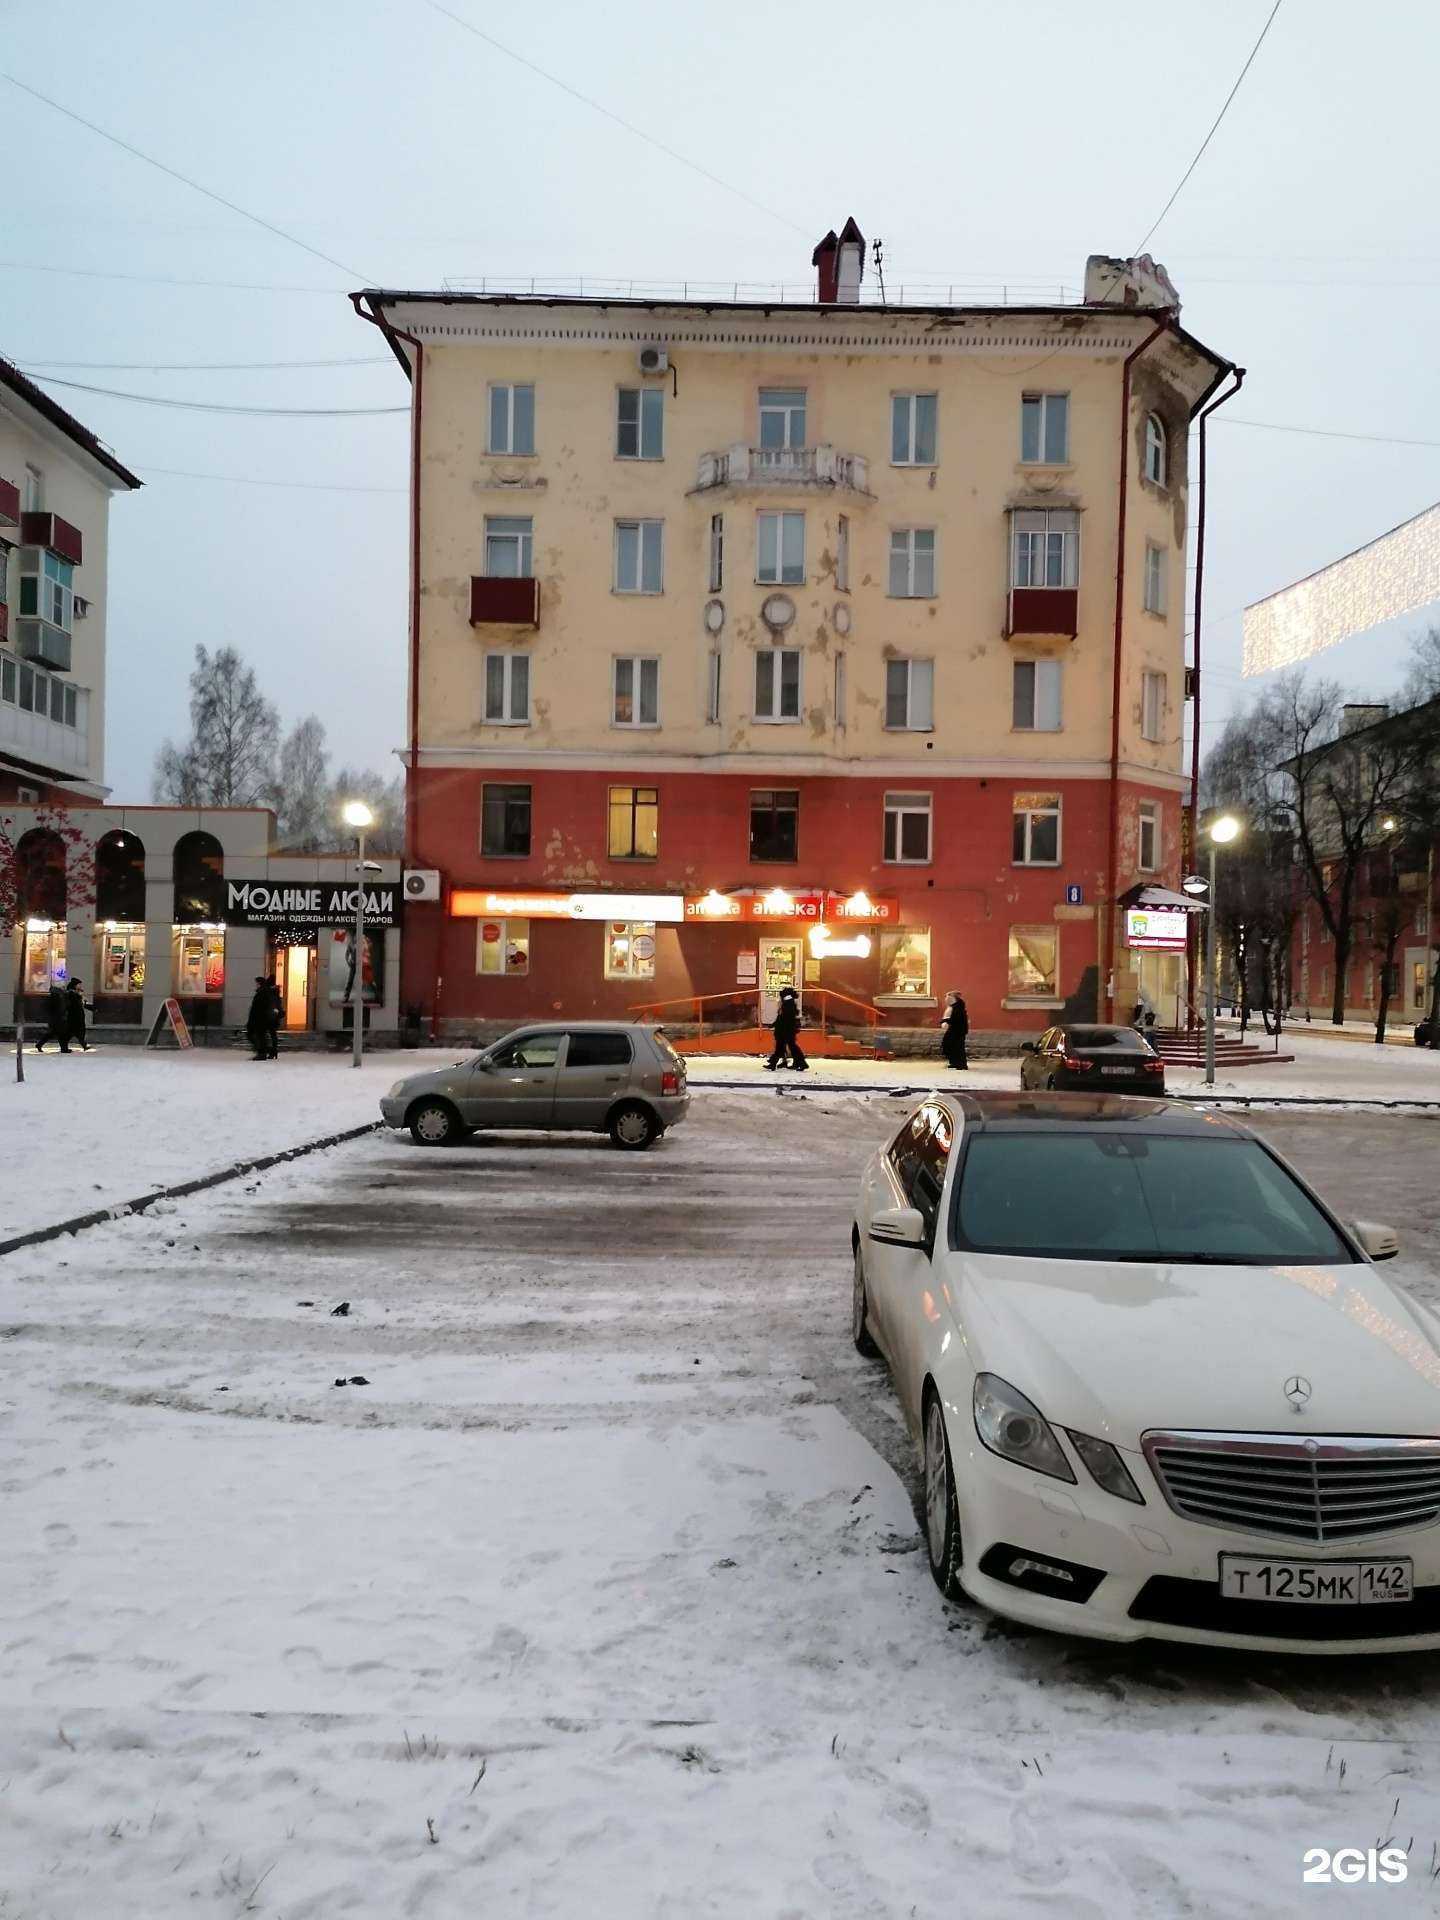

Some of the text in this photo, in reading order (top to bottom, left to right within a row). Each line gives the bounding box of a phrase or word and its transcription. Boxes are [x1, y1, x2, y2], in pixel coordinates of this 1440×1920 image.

[228, 882, 393, 914] МОДНЫЕ ЛЮДИ
[1071, 887, 1078, 902] 8
[752, 902, 816, 916] апека
[836, 904, 889, 917] апка
[248, 914, 393, 924] МАГАЗИН ОДЕЖДЫ И АКСЕСУАРОВ
[1363, 1566, 1405, 1591] 142
[1372, 1590, 1393, 1599] RUS
